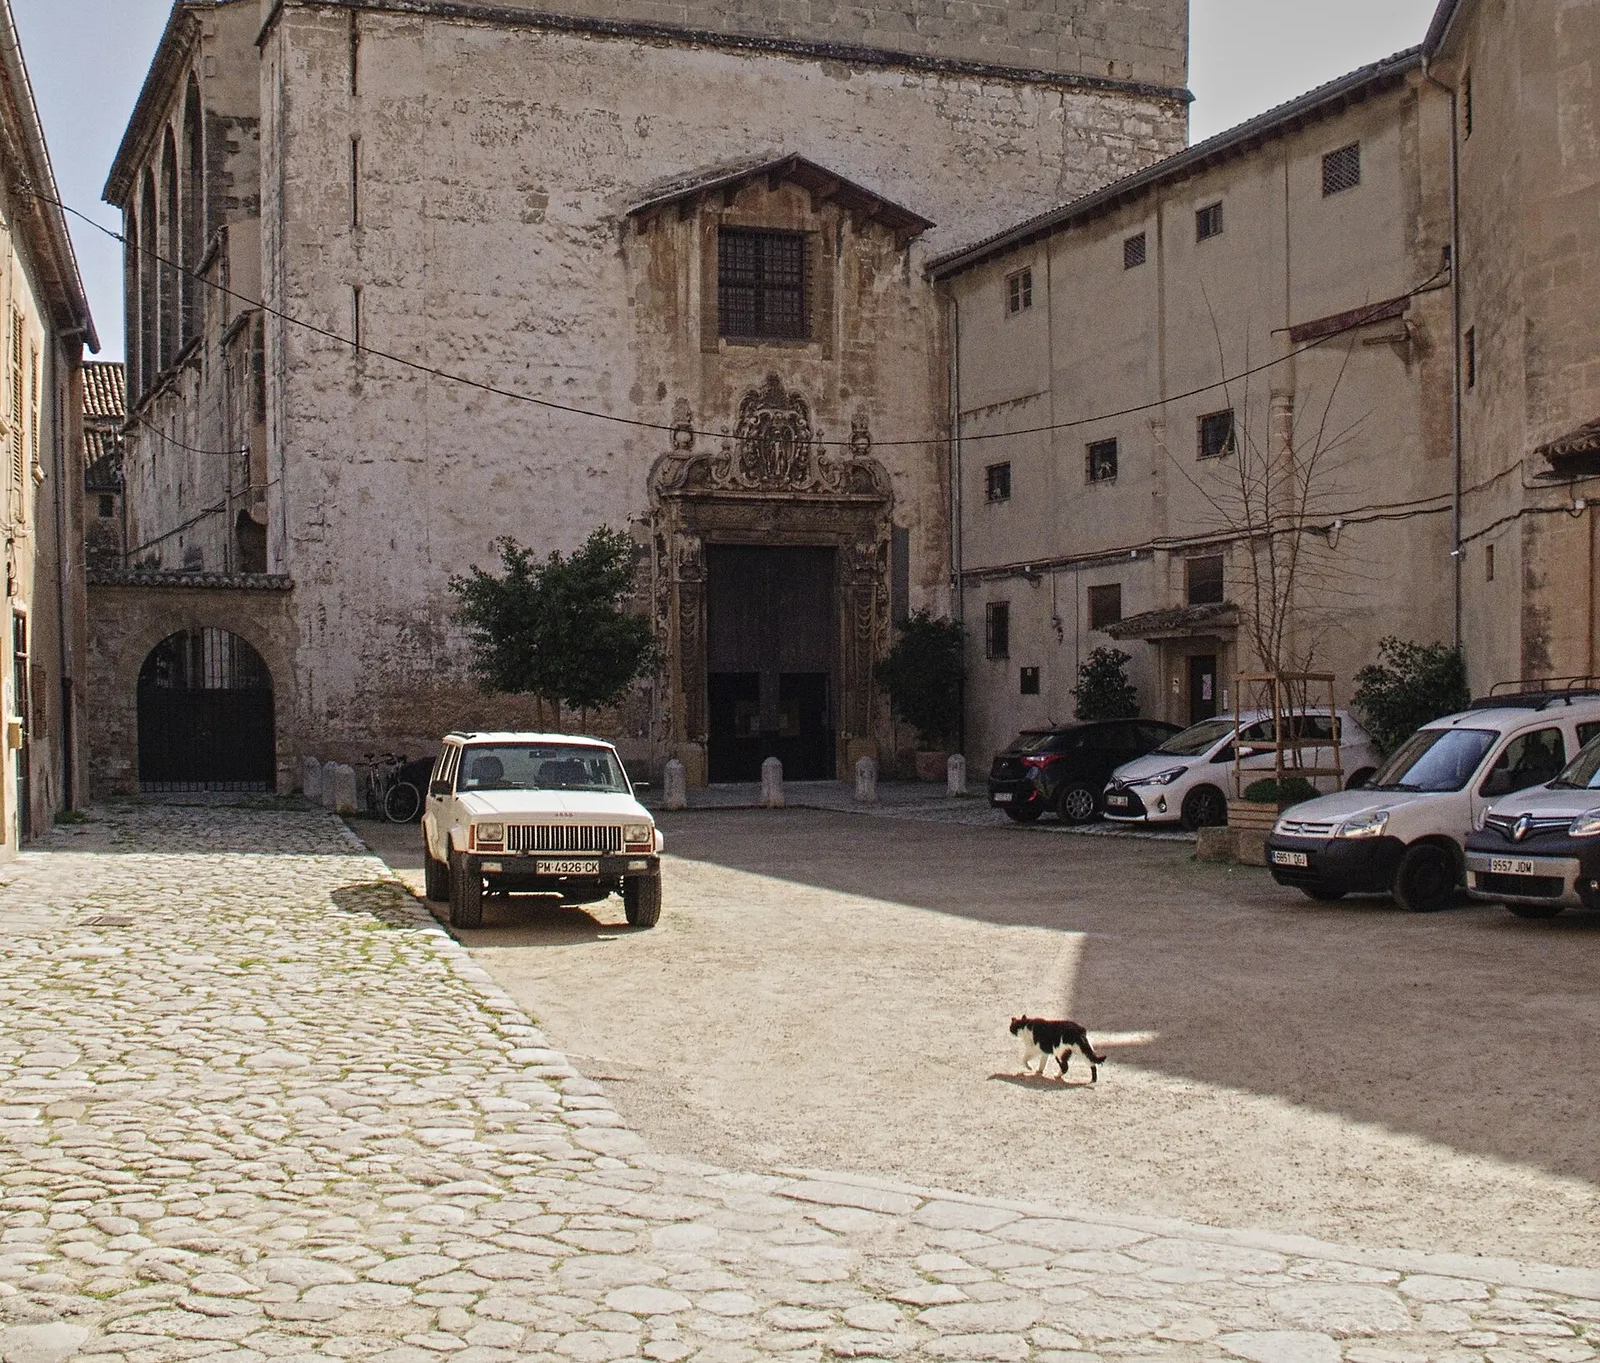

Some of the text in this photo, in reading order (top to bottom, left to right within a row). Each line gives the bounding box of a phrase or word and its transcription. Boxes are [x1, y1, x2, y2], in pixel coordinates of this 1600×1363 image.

[555, 862, 581, 872] 4926
[585, 862, 598, 872] CK
[1493, 860, 1531, 873] 9557 JDM
